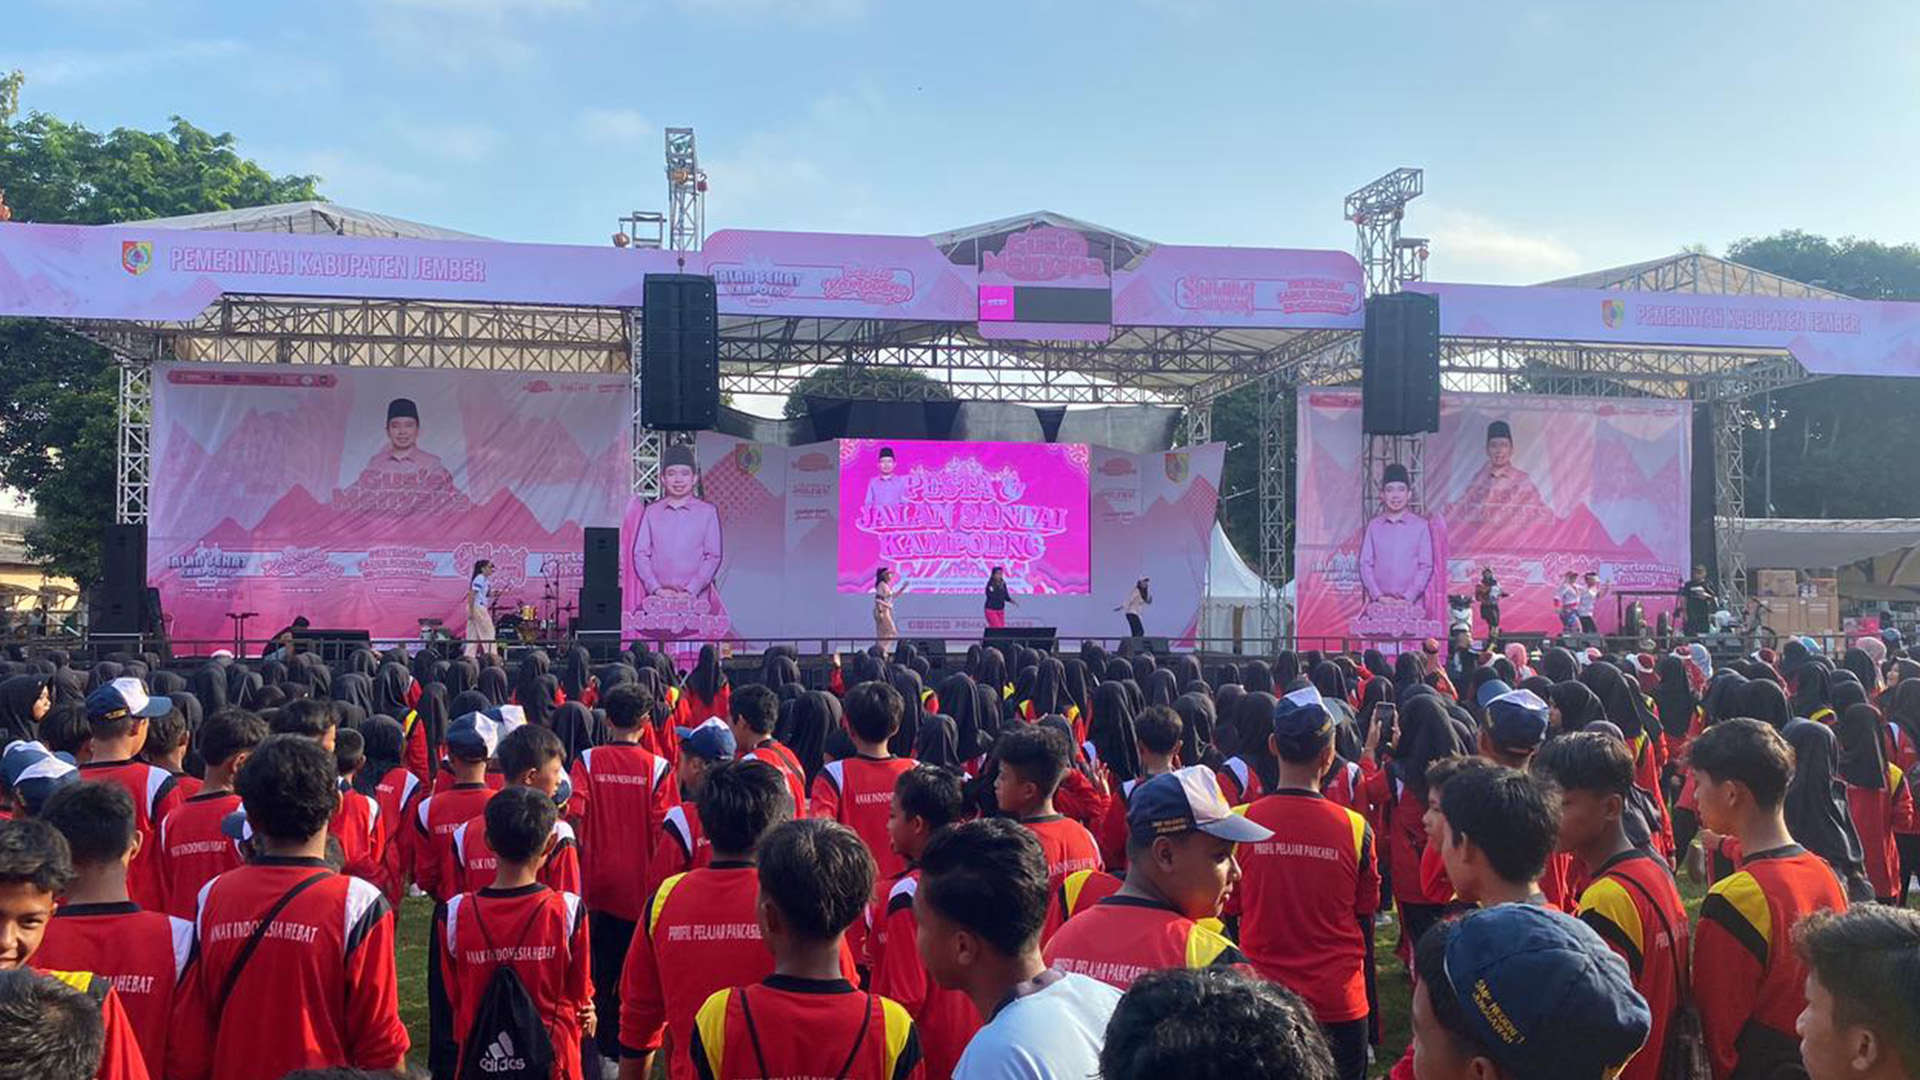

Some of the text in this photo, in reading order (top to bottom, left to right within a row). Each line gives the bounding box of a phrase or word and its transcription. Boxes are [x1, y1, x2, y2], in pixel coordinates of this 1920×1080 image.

[170, 248, 486, 282] PEMERINTAH KABUPATEN JEMBER
[1635, 304, 1861, 333] PEMERINTAH KABUPATEN JEMBER
[906, 470, 994, 500] PESTA
[855, 503, 955, 532] JALAN
[958, 504, 1069, 534] SANTAI
[879, 532, 1047, 560] KAMPOENG
[1612, 562, 1680, 575] Pertemuan
[1254, 842, 1339, 861] PROFIL PELAJAR PANCASILA
[284, 922, 319, 944] HEBAT
[668, 925, 692, 941] PROFIL
[693, 924, 725, 941] PELAJAR
[117, 974, 154, 994] HEBAT
